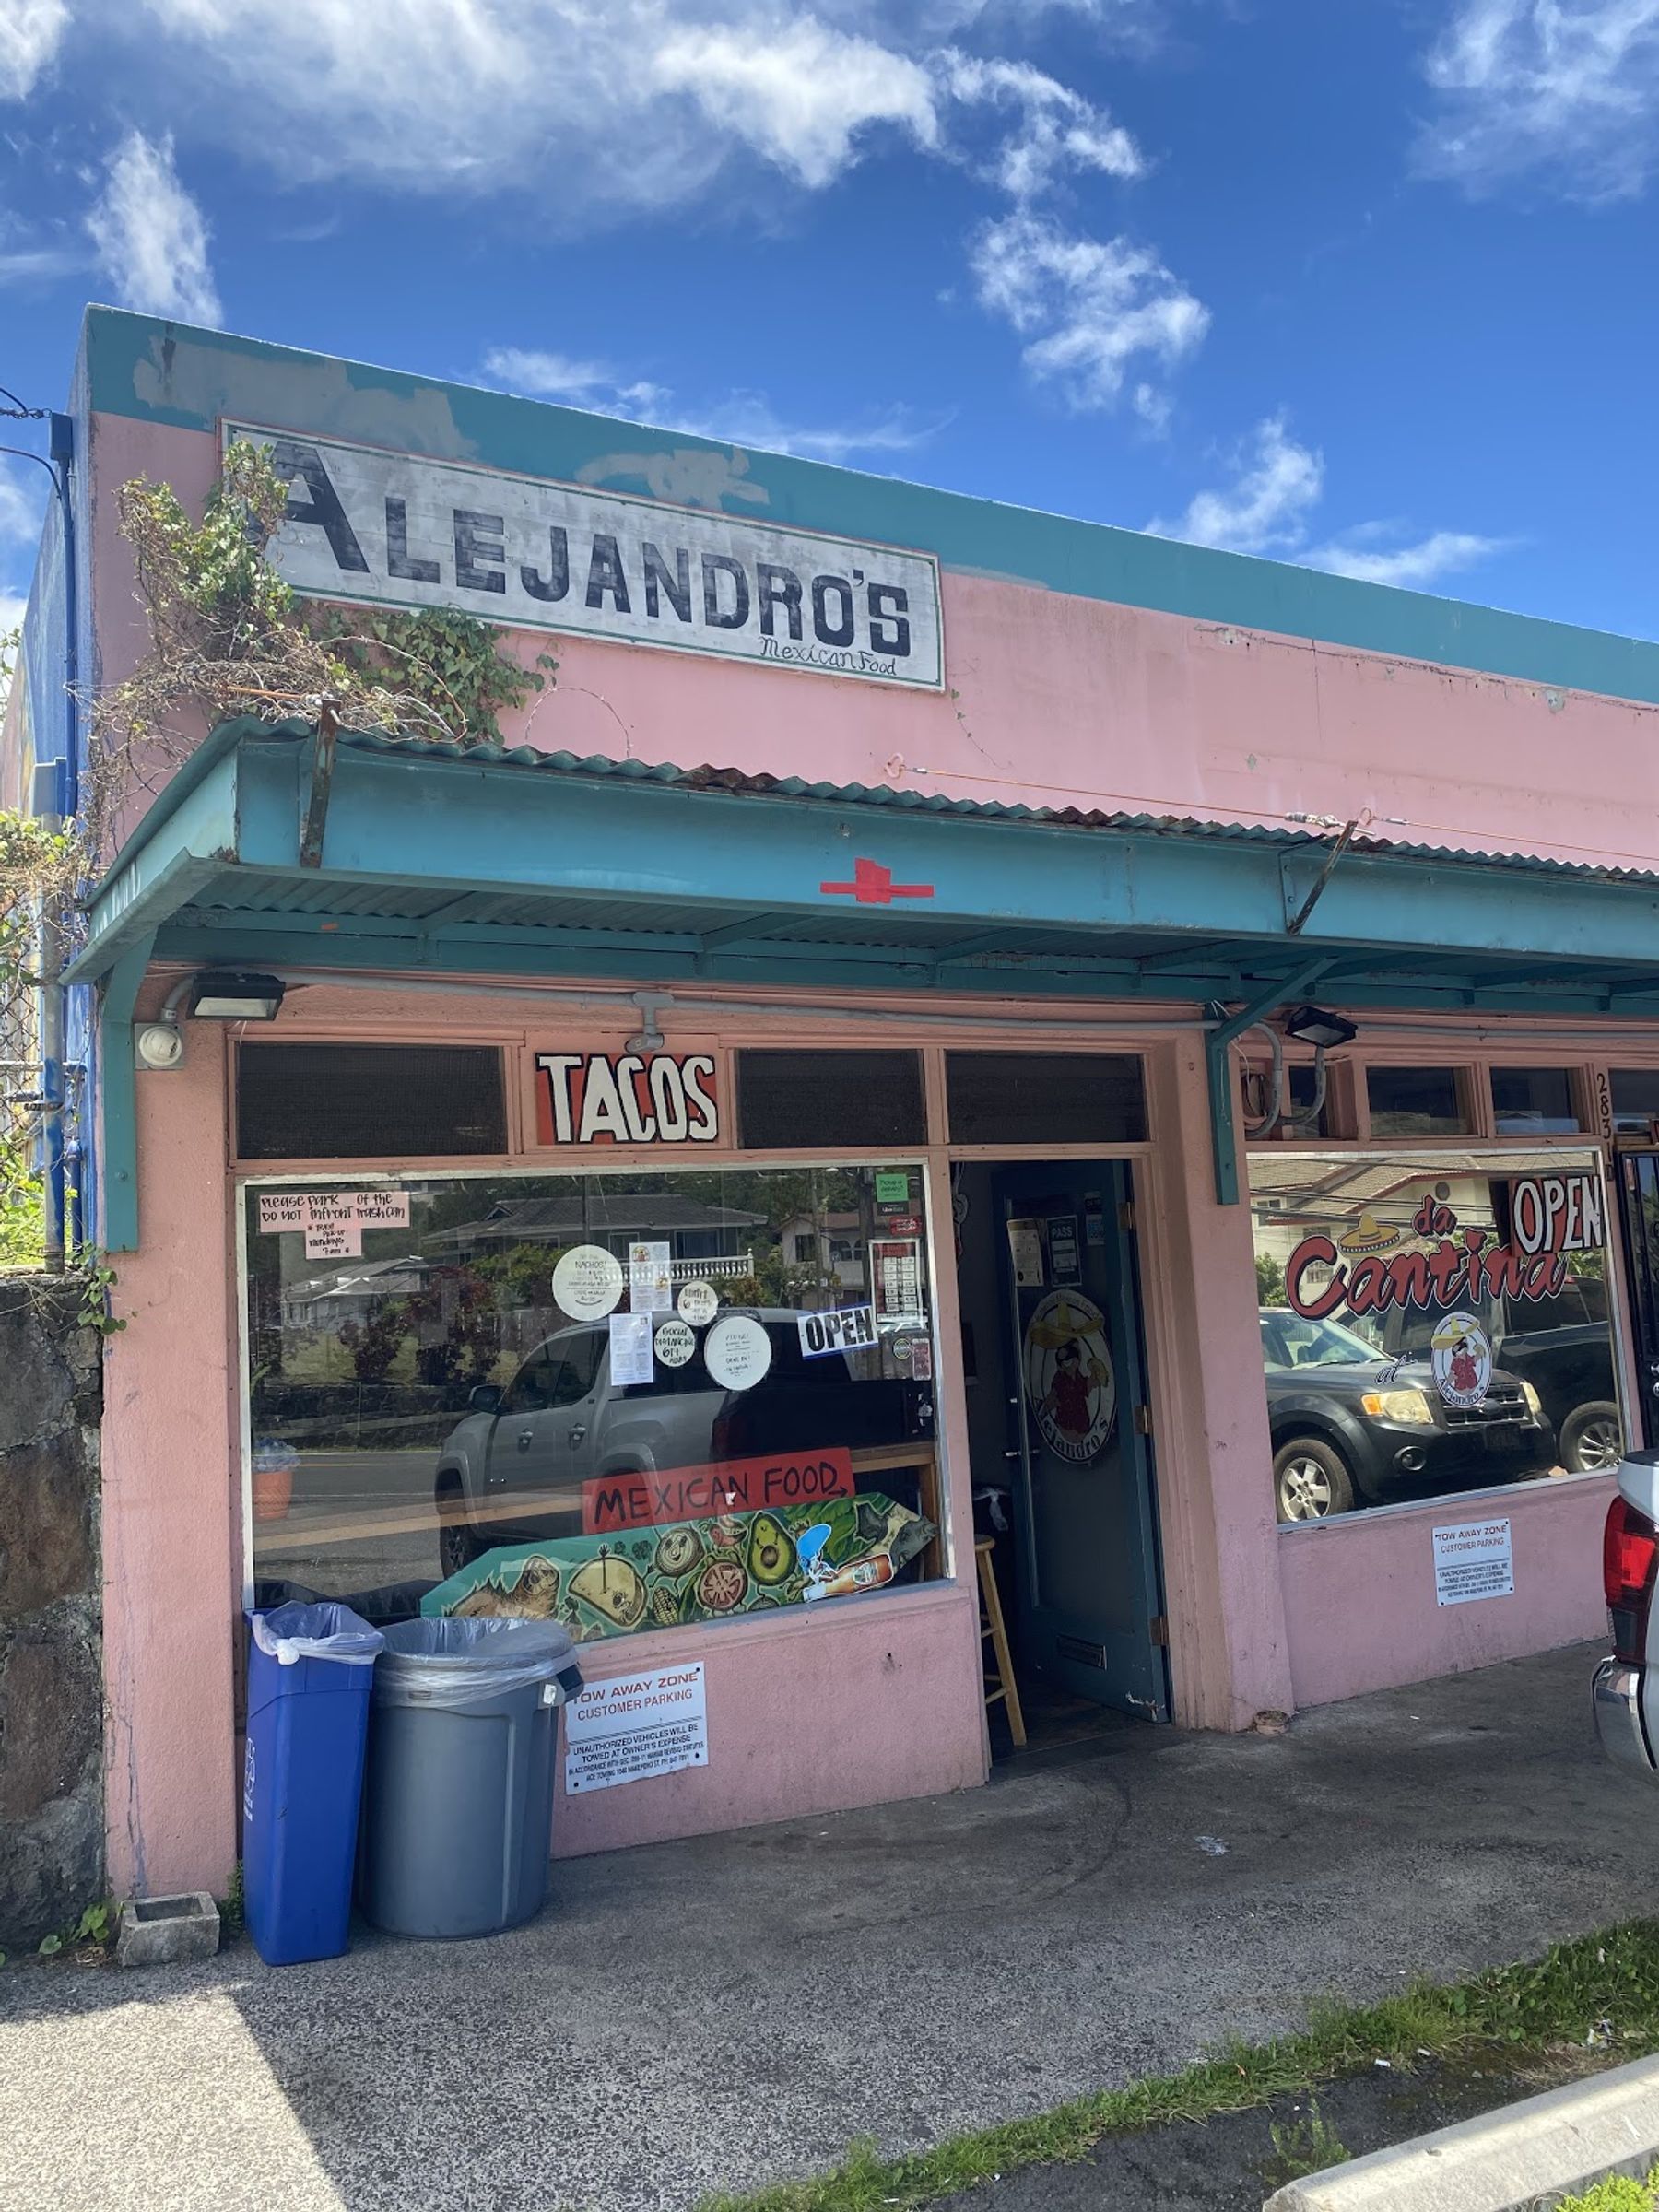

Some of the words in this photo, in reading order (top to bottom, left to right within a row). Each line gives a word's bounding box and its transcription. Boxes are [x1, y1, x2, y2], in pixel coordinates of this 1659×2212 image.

[247, 441, 912, 658] ALEJANDRO'S
[758, 636, 856, 669] Mexican
[857, 650, 898, 676] Food
[536, 1053, 718, 1143] TACOS
[1052, 1226, 1073, 1239] PASS
[1413, 1194, 1458, 1237] da
[1512, 1173, 1604, 1254] OPEN
[1287, 1228, 1569, 1321] Cantina
[806, 1307, 875, 1352] OPEN
[594, 1472, 749, 1524] MEXICAN
[764, 1461, 837, 1504] FOOD
[1441, 1541, 1476, 1554] CUSTOMER
[1477, 1536, 1504, 1547] PARKING
[1459, 1528, 1482, 1538] AWAY
[1484, 1524, 1507, 1535] ZONE
[577, 1699, 641, 1721] CUSTOMER
[644, 1688, 693, 1707] PARKING
[611, 1680, 653, 1698] AWAY
[658, 1672, 698, 1688] ZONE
[573, 1736, 633, 1756] UNAUTHORIZED
[633, 1730, 670, 1746] VEHICLES
[670, 1725, 687, 1736] WILL
[688, 1723, 699, 1732] BE
[582, 1751, 609, 1763] TOWED
[611, 1749, 620, 1759] AT
[657, 1734, 691, 1748] EXPENSE
